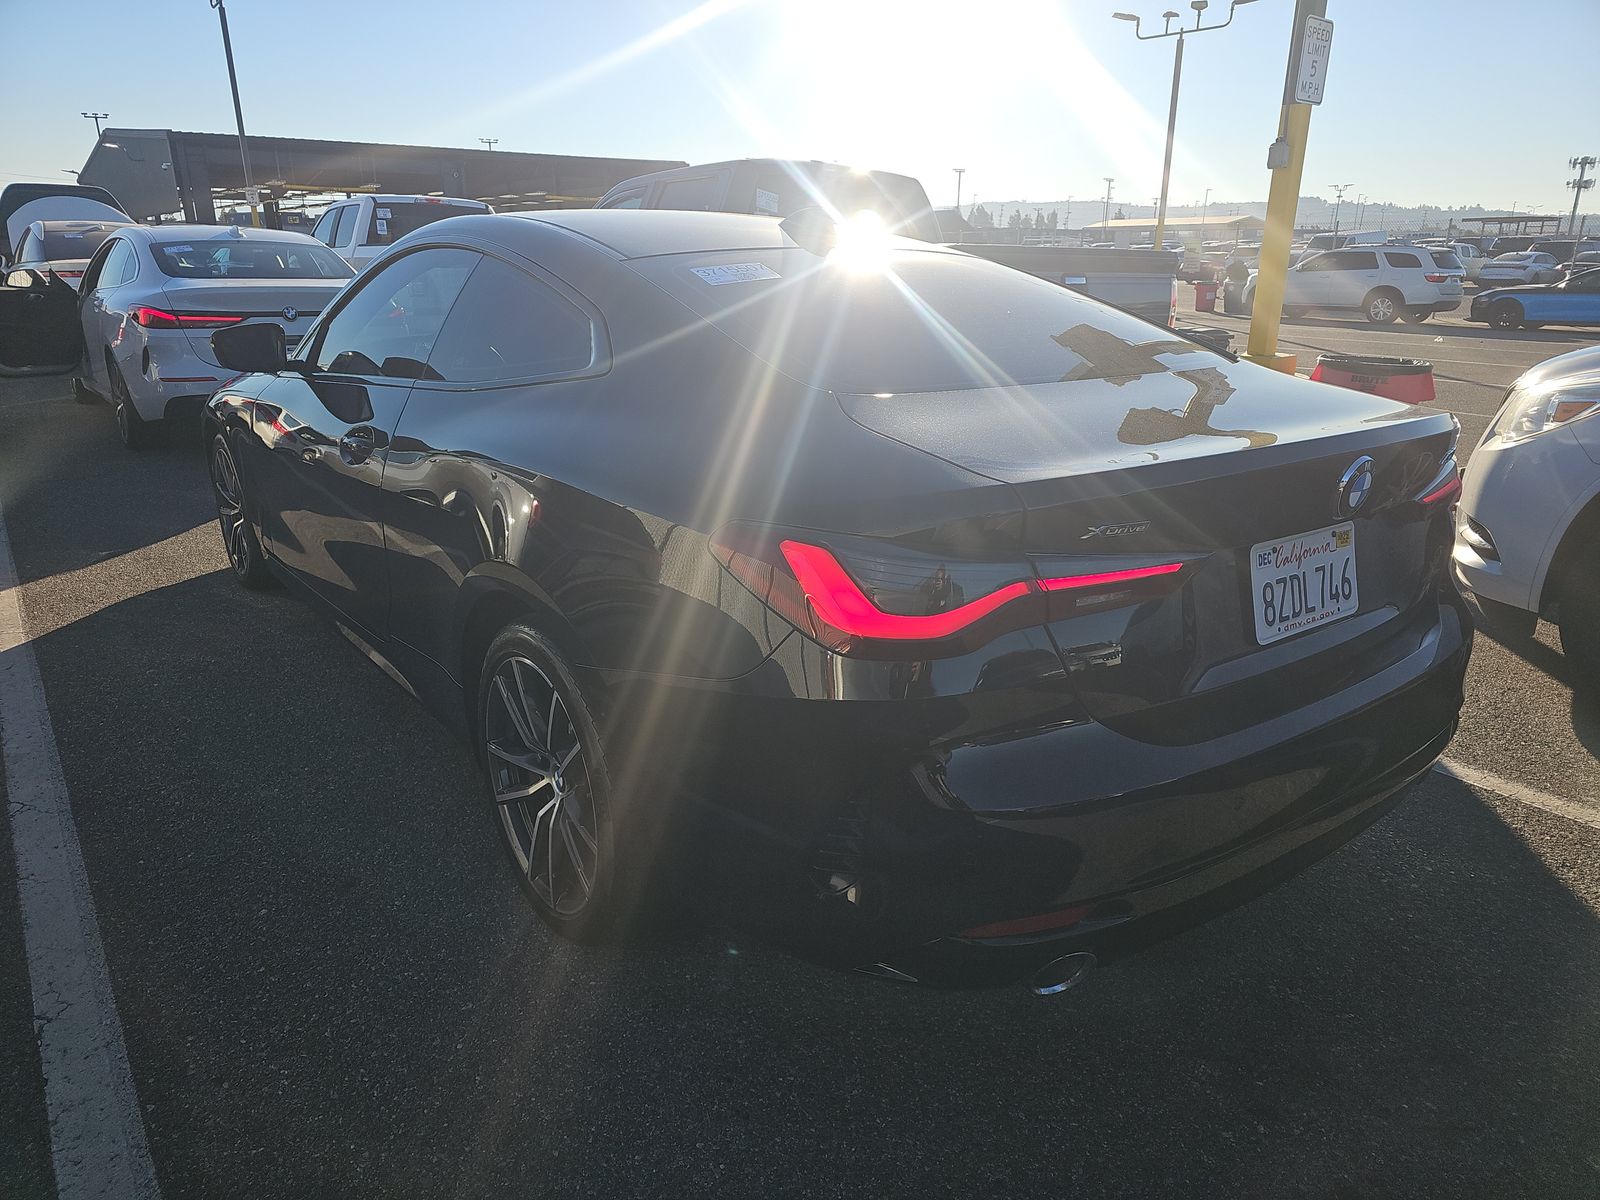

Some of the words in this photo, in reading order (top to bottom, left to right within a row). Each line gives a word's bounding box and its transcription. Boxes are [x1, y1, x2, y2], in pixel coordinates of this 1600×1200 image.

[1308, 26, 1330, 42] SPEED
[1308, 43, 1327, 58] LIMIT
[1310, 60, 1318, 77] 5
[1258, 551, 1272, 567] DEC
[1275, 539, 1337, 569] California
[1262, 556, 1352, 627] 8ZDL746
[1284, 610, 1336, 632] dmv.ca.gov
